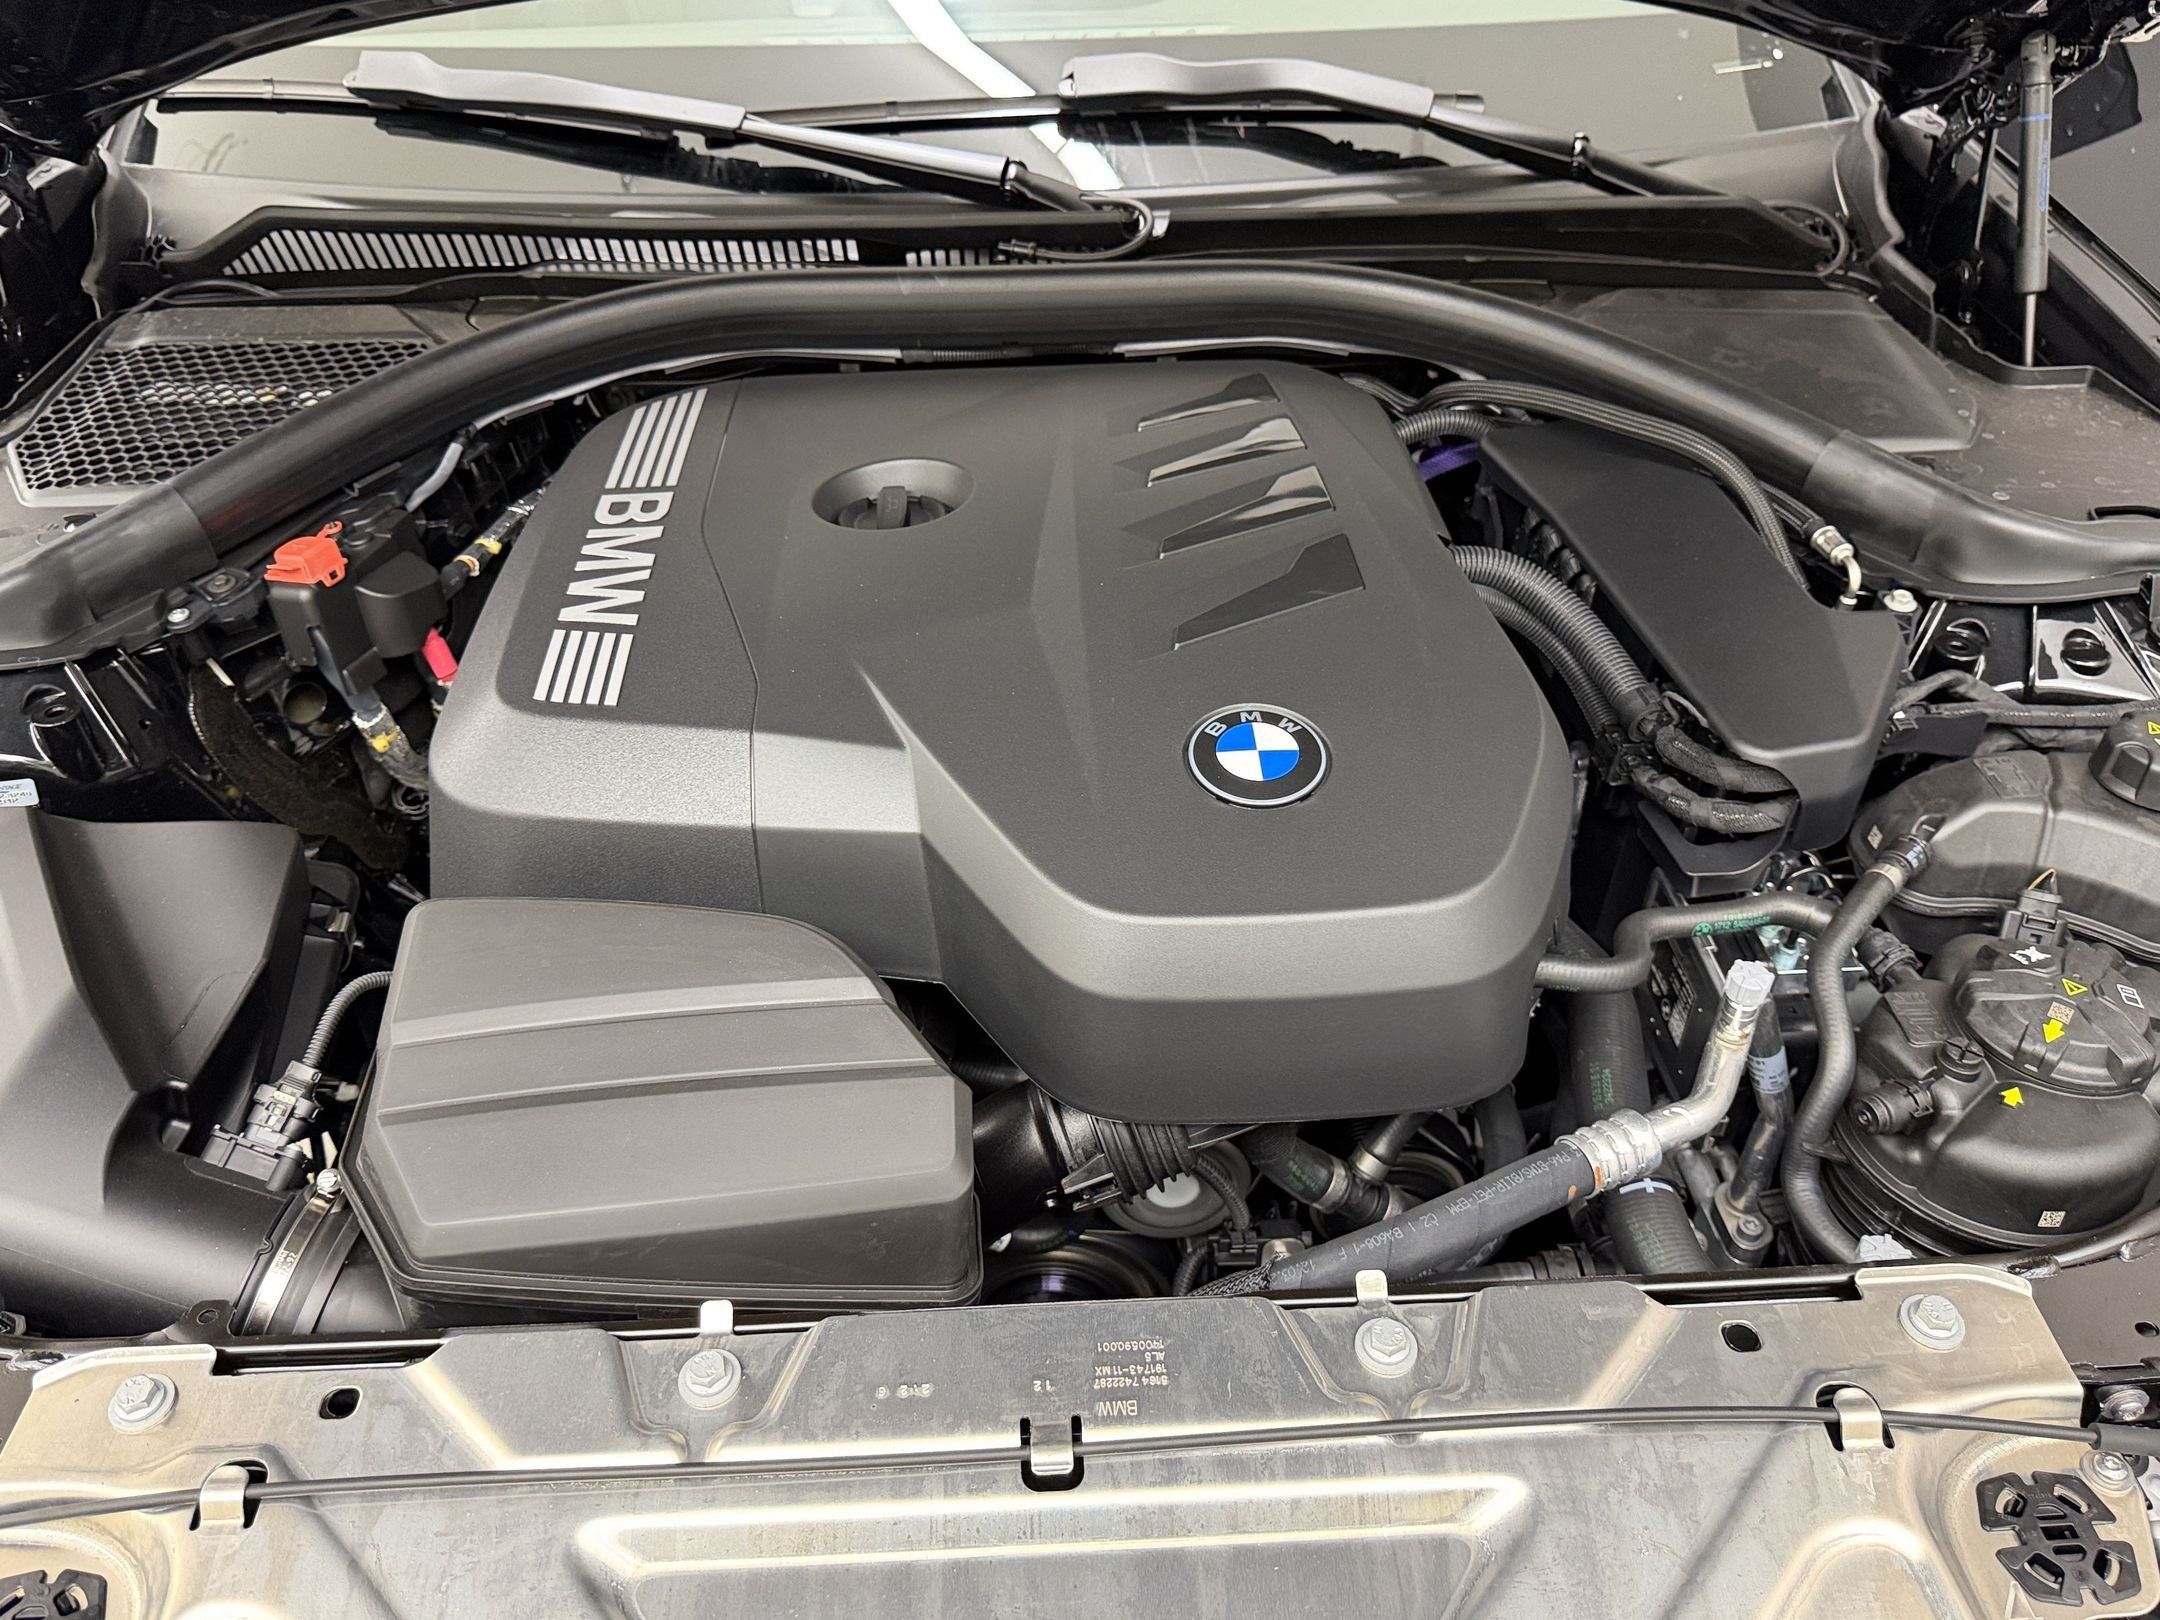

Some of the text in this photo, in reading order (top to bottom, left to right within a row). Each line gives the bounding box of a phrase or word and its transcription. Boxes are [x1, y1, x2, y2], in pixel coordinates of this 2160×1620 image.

[558, 491, 675, 627] BMW
[1203, 711, 1303, 738] BMW
[1093, 1376, 1140, 1390] 7422287
[1097, 1399, 1138, 1417] BMW
